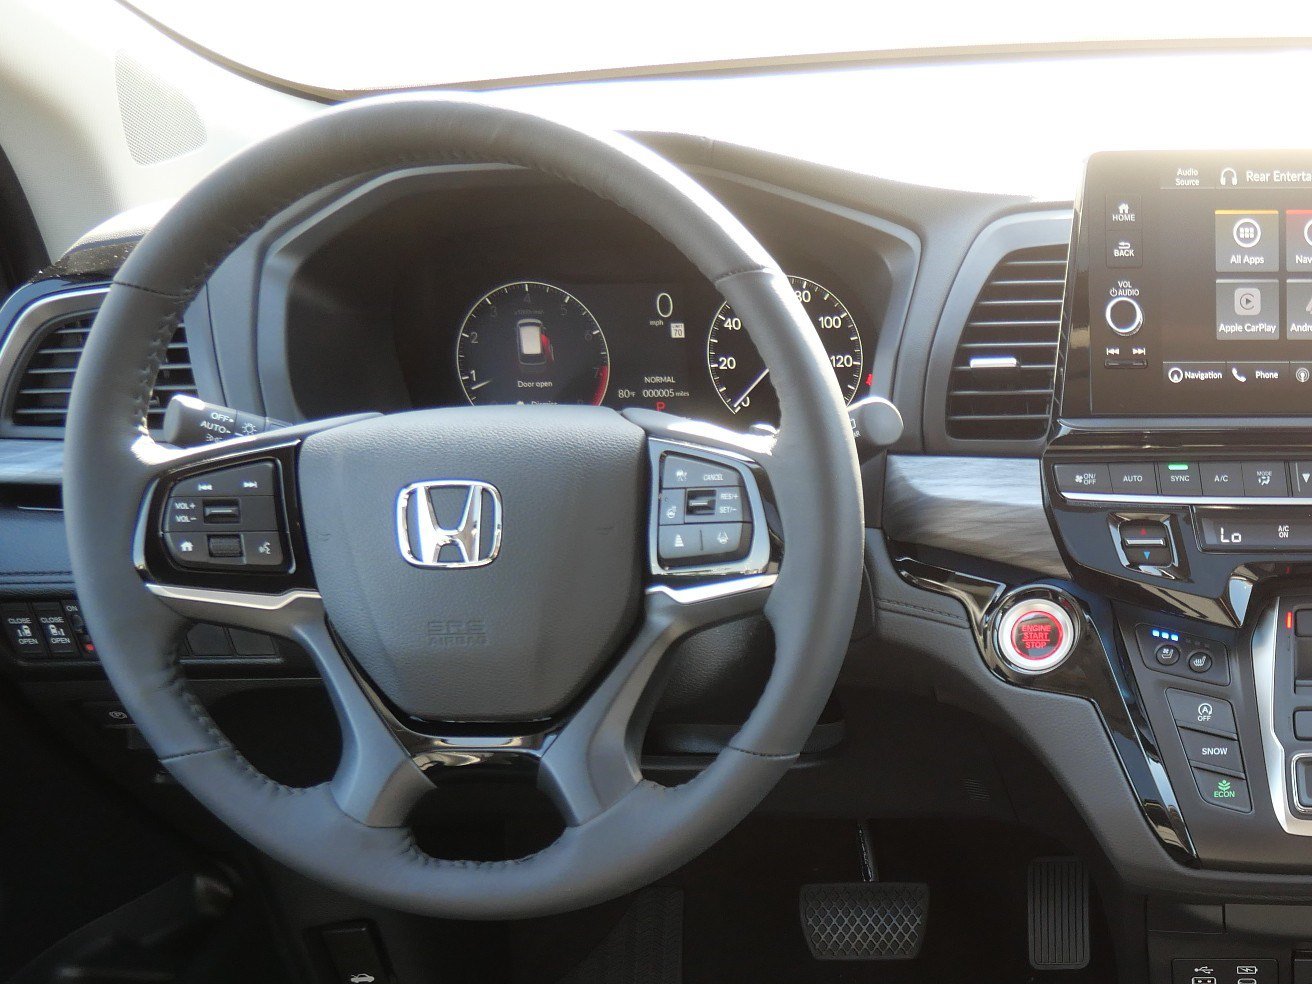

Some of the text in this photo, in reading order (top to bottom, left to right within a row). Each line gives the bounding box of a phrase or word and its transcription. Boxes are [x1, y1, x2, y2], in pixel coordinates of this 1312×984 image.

[1177, 168, 1199, 176] Audio
[1246, 171, 1269, 182] Rear
[1175, 178, 1200, 187] Source
[1112, 214, 1136, 222] HOME
[1114, 249, 1135, 257] BACK
[1230, 254, 1264, 266] All Apps
[657, 293, 673, 318] 0
[724, 318, 742, 331] 40
[819, 316, 842, 329] 100
[674, 329, 683, 337] 70
[1219, 323, 1276, 334] Apple CarPlay
[470, 331, 479, 344] 2
[718, 357, 736, 370] 20
[830, 355, 853, 368] 120
[470, 370, 476, 381] 1
[1184, 370, 1222, 381] Navigation
[1255, 370, 1278, 379] Phone
[642, 389, 675, 397] 000005
[211, 412, 230, 423] OFF
[200, 421, 227, 434] AUTO
[1214, 475, 1229, 483] A/C
[1220, 527, 1242, 543] Lo
